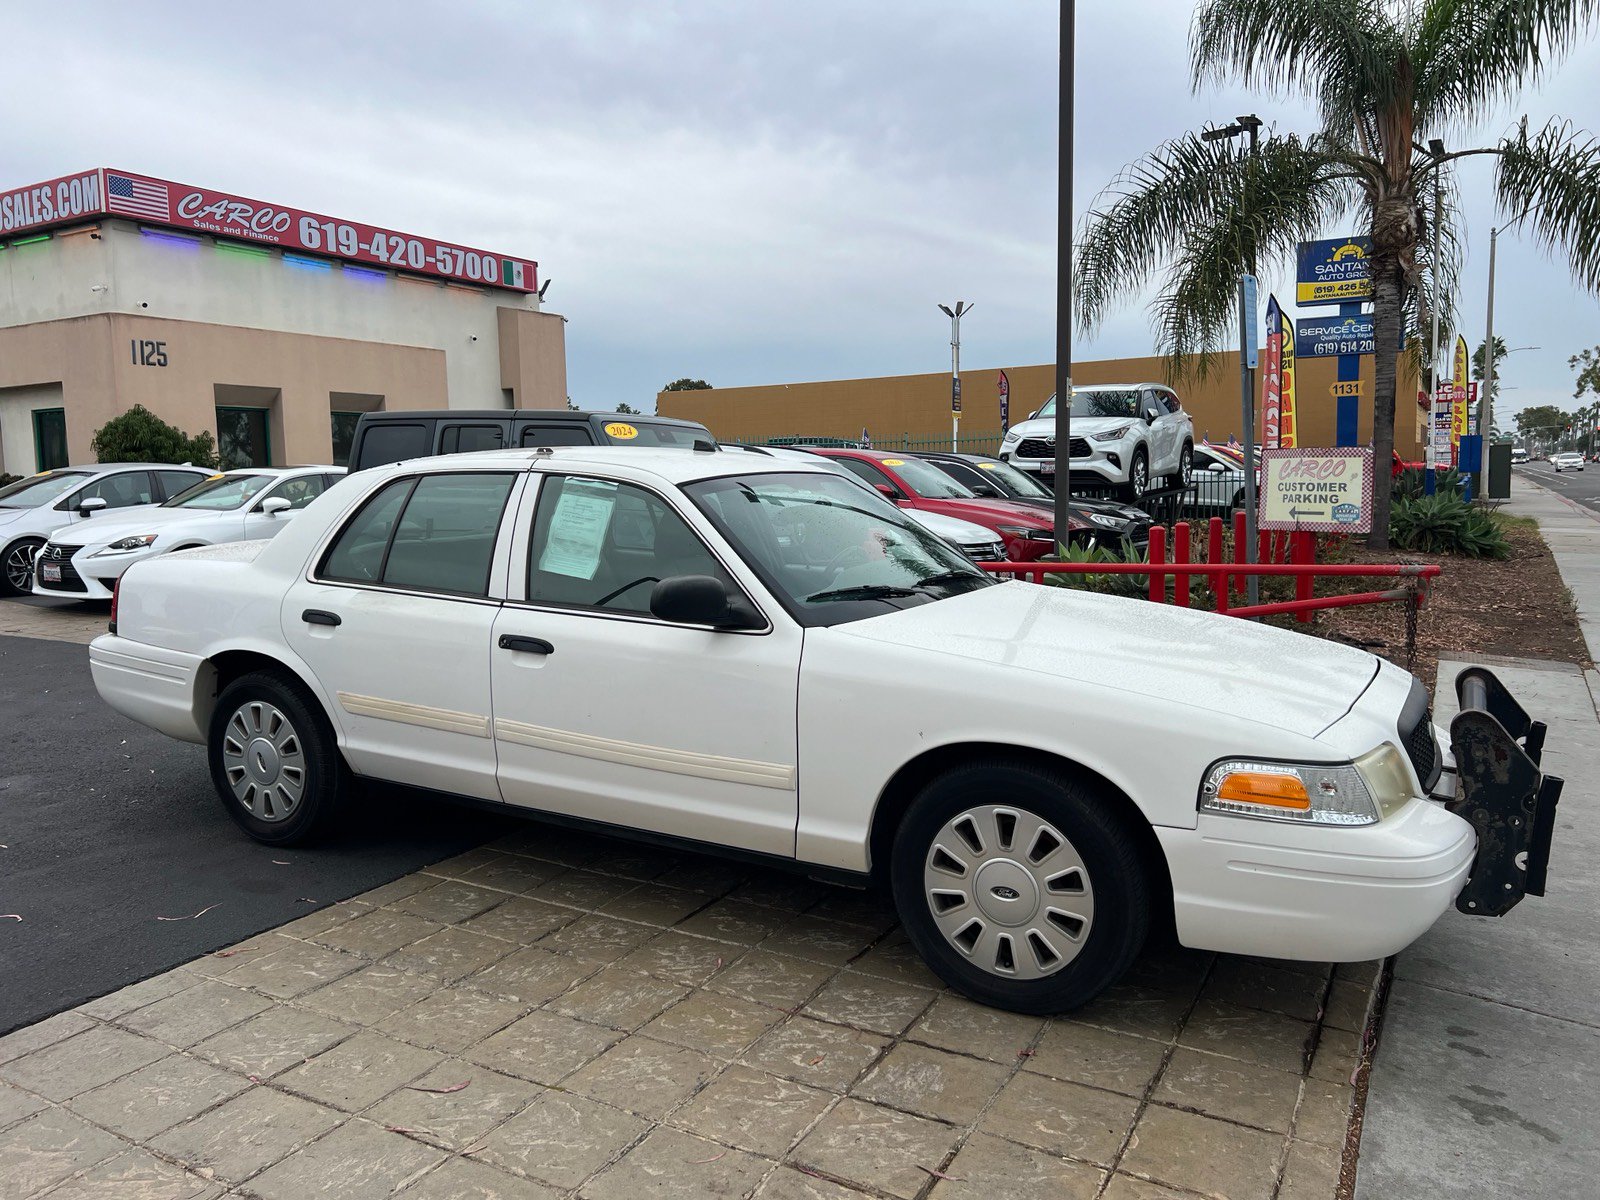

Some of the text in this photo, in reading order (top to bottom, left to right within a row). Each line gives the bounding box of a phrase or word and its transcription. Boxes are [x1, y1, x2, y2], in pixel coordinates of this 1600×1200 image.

[0, 174, 100, 231] SALES.COM
[193, 219, 280, 242] Sales and Finance
[177, 192, 498, 283] CARCO 619-420-5700
[1315, 261, 1371, 274] SANTAN
[1318, 273, 1345, 281] AUTO
[1313, 285, 1336, 294] (619)
[1300, 324, 1375, 337] SERVICE CEN
[131, 339, 168, 367] 1125
[1313, 342, 1338, 354] (619)
[1340, 341, 1358, 353] 614
[1332, 383, 1360, 395] 1131
[610, 426, 633, 436] 2024
[1279, 459, 1347, 480] CARCO
[1277, 482, 1348, 492] CUSTOMER
[1282, 494, 1339, 504] PARKING
